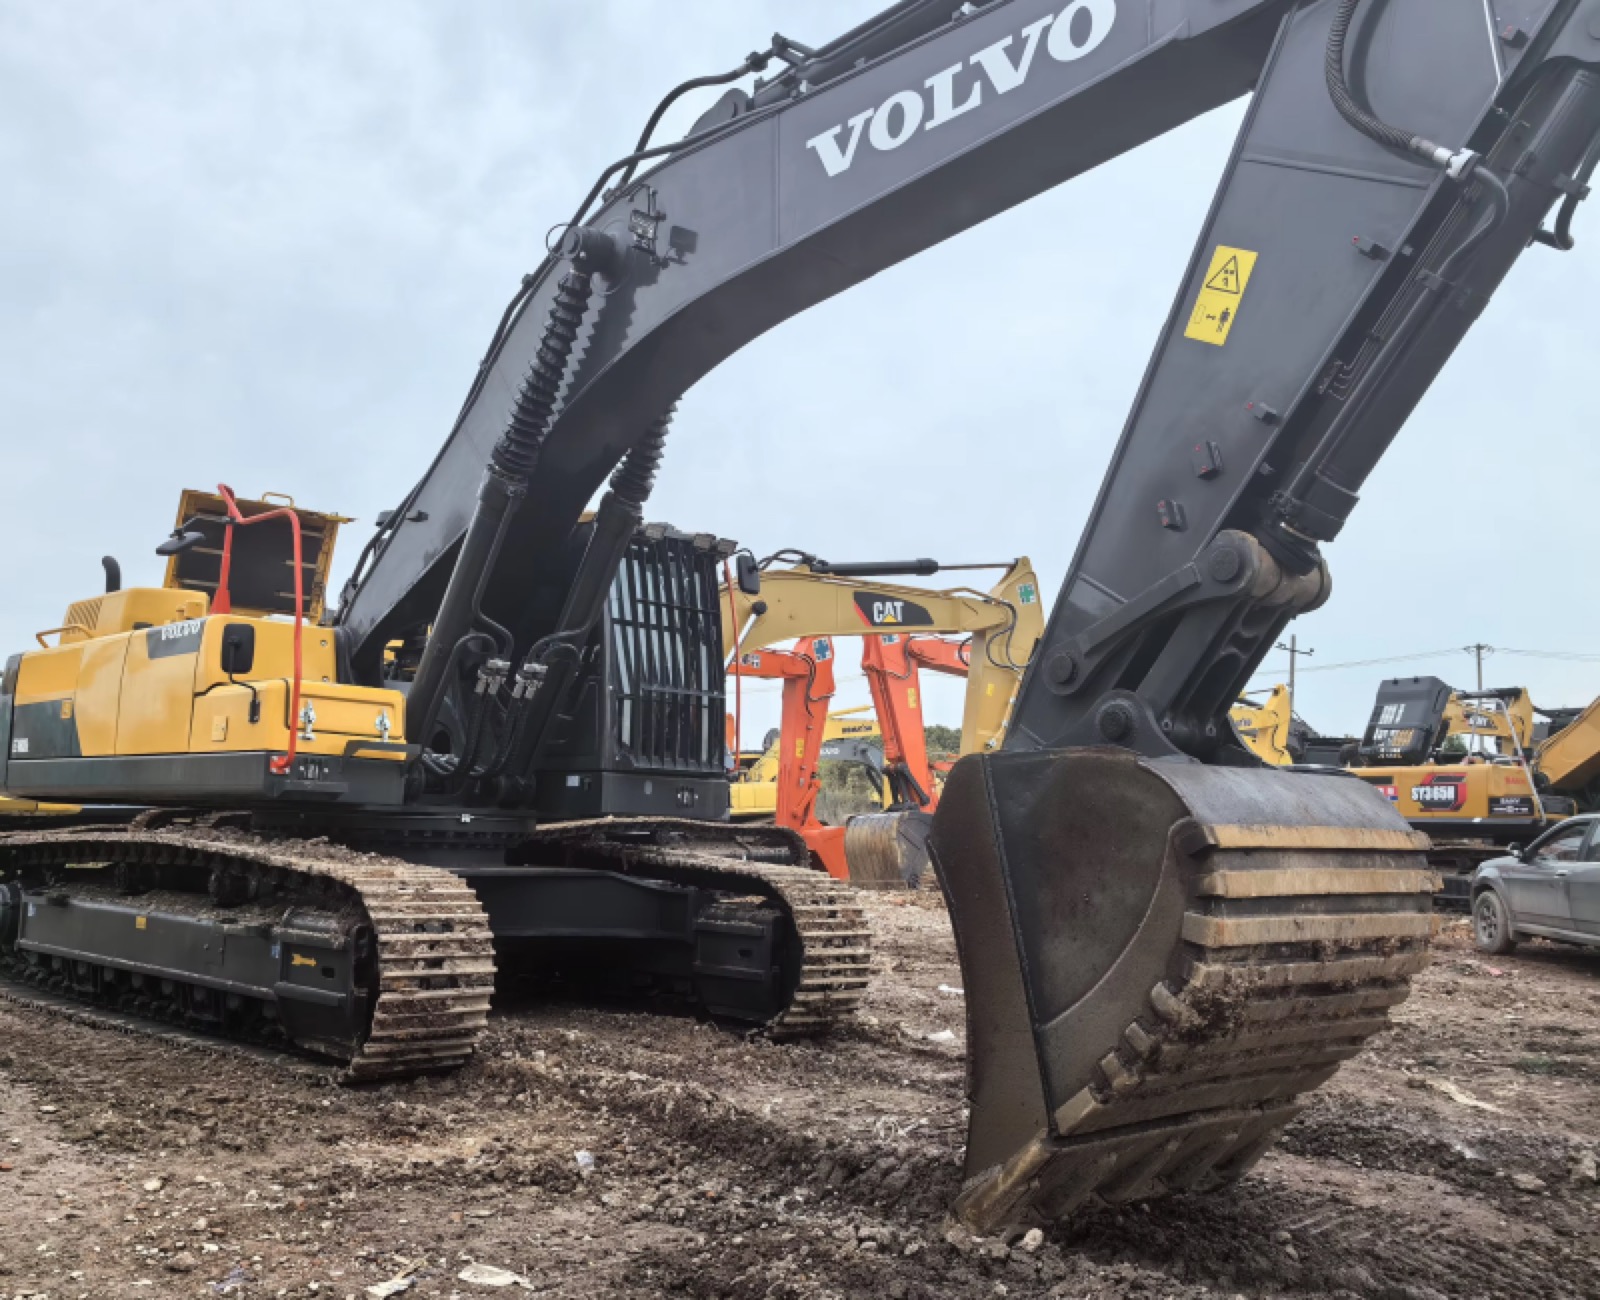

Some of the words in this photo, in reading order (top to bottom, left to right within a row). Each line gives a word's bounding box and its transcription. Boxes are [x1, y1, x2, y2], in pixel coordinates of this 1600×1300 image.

[805, 0, 1117, 177] VOLVO
[873, 601, 904, 622] CAT
[161, 620, 201, 640] VOLVO
